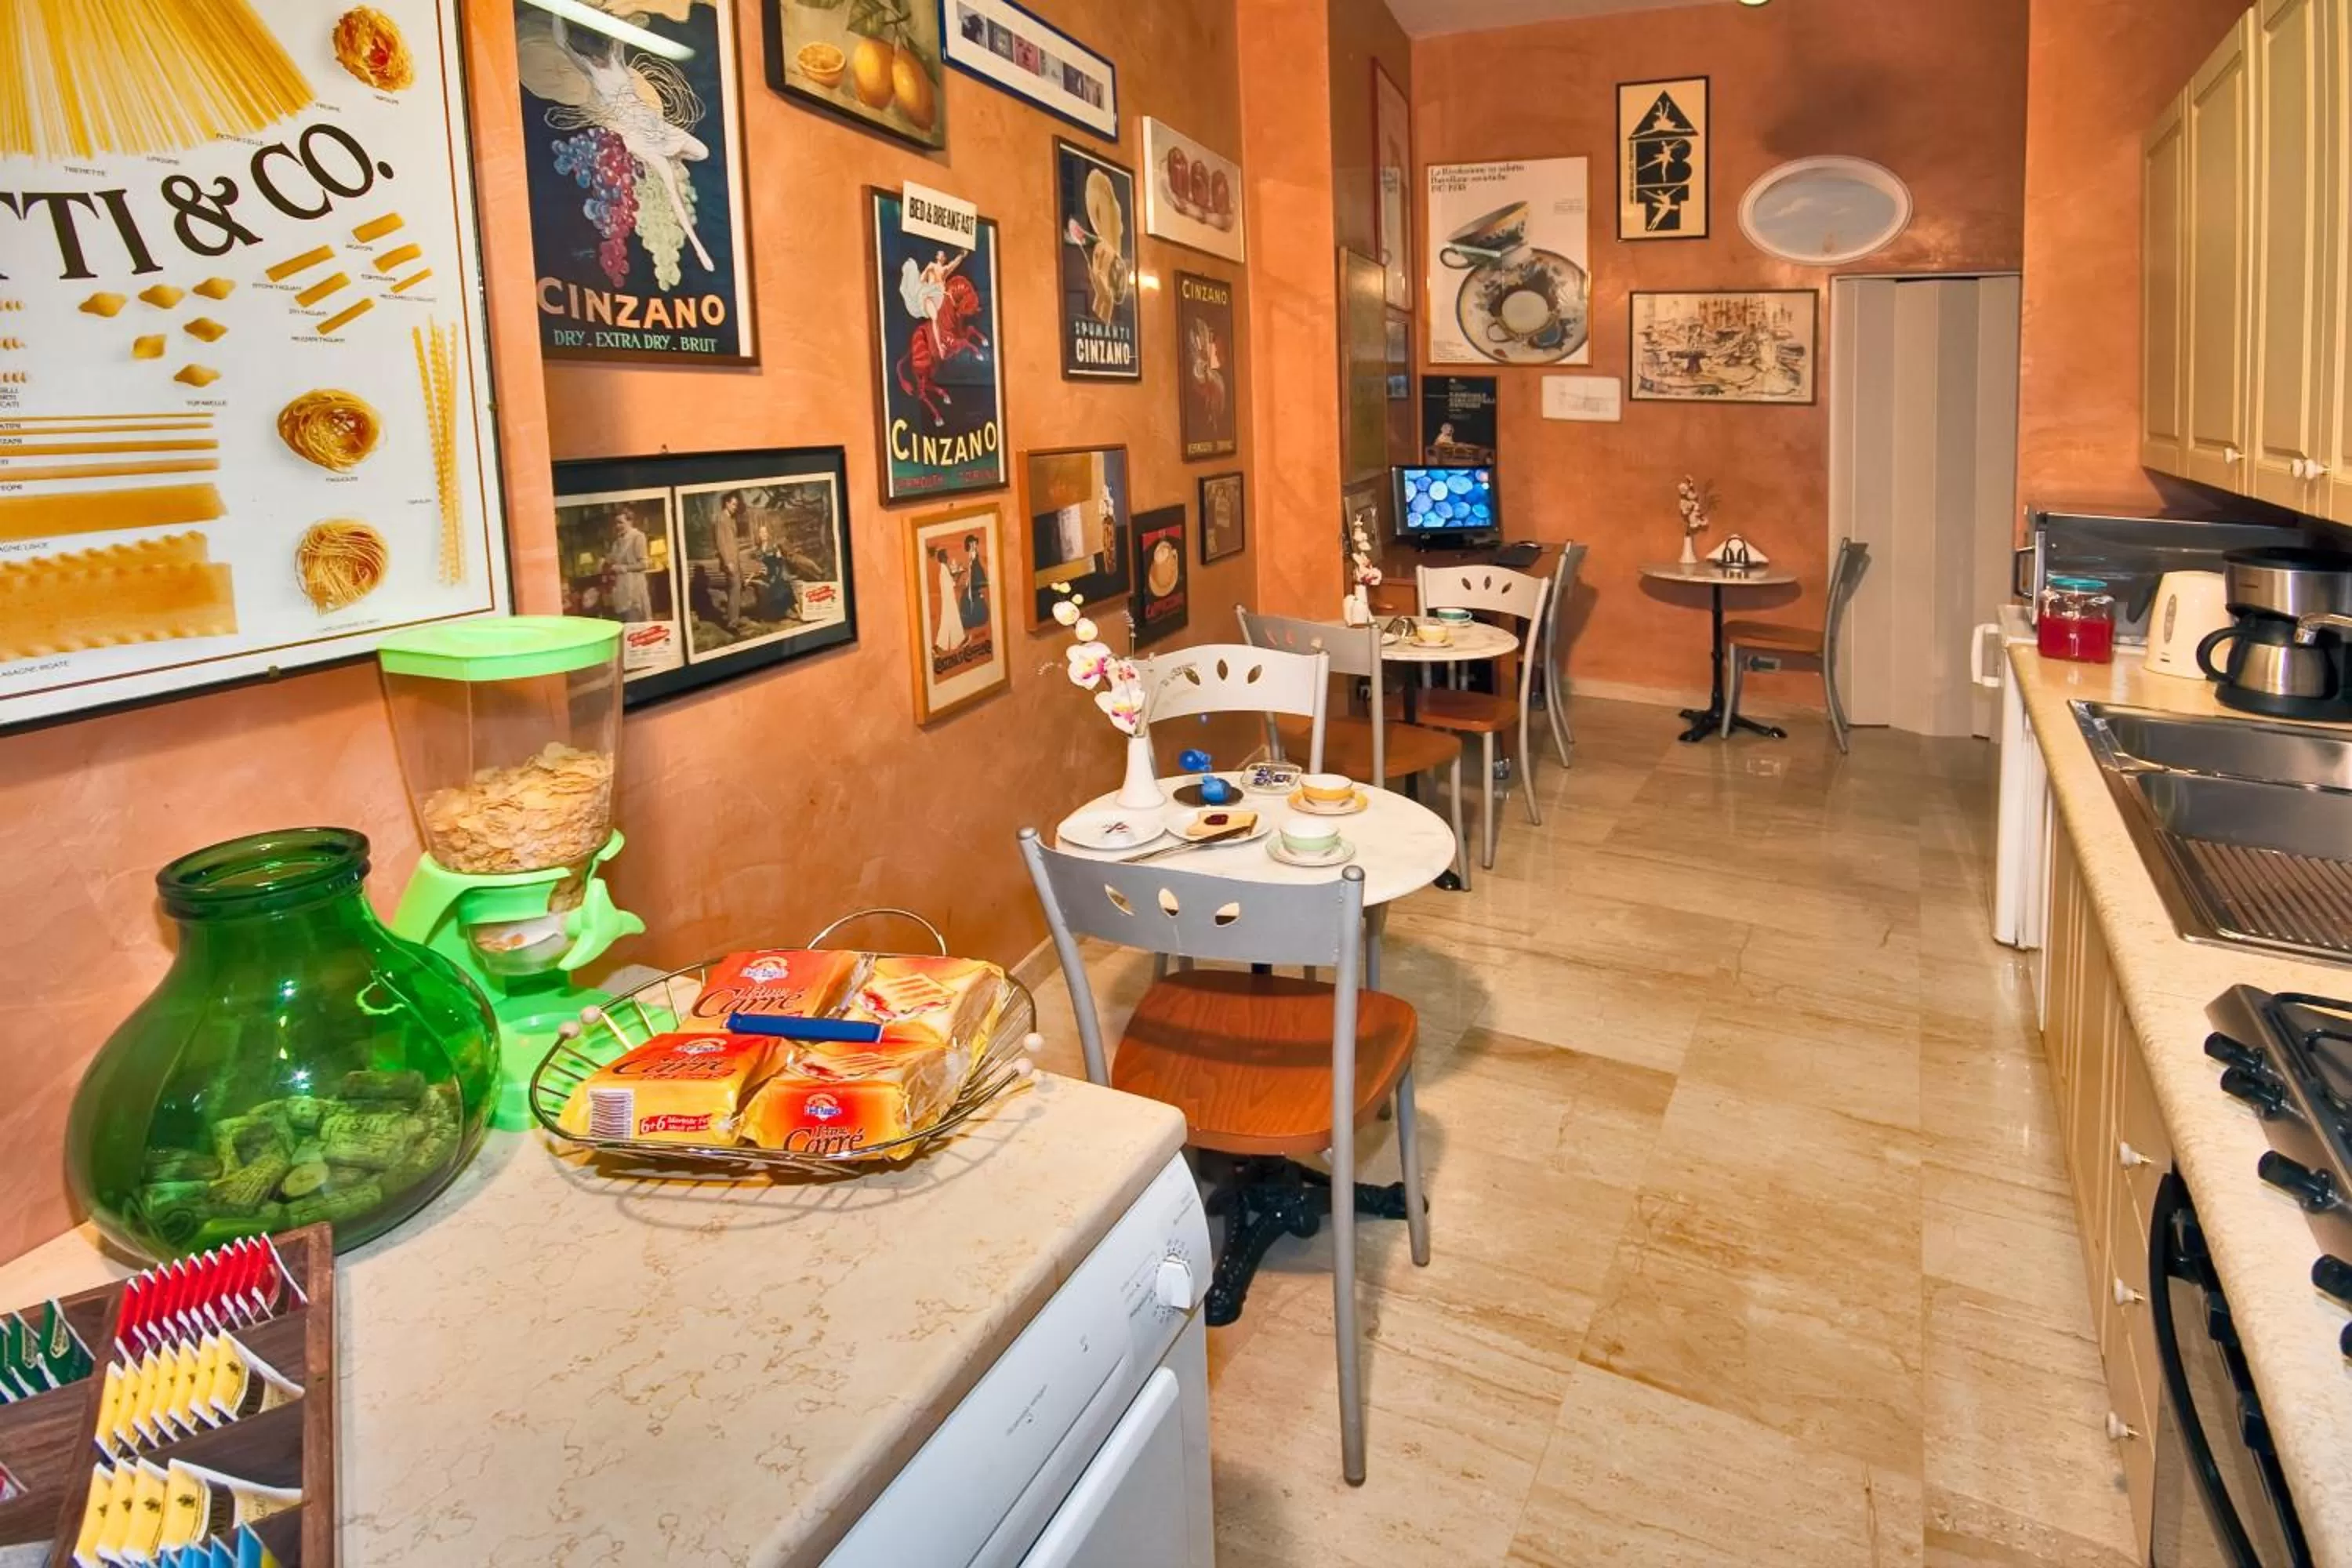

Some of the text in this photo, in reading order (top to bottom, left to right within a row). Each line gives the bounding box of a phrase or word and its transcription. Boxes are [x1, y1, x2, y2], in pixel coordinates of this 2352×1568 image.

[0, 123, 394, 280] TI & CO.
[909, 196, 974, 235] BED & BREAKFAST
[536, 276, 726, 329] CINZANO
[1181, 278, 1228, 306] CINZANO
[595, 332, 638, 350] EXTRA
[680, 336, 718, 352] BRUT
[1076, 338, 1130, 365] CINZANO
[891, 419, 997, 466] CINZANO
[641, 1116, 666, 1134] 6+6
